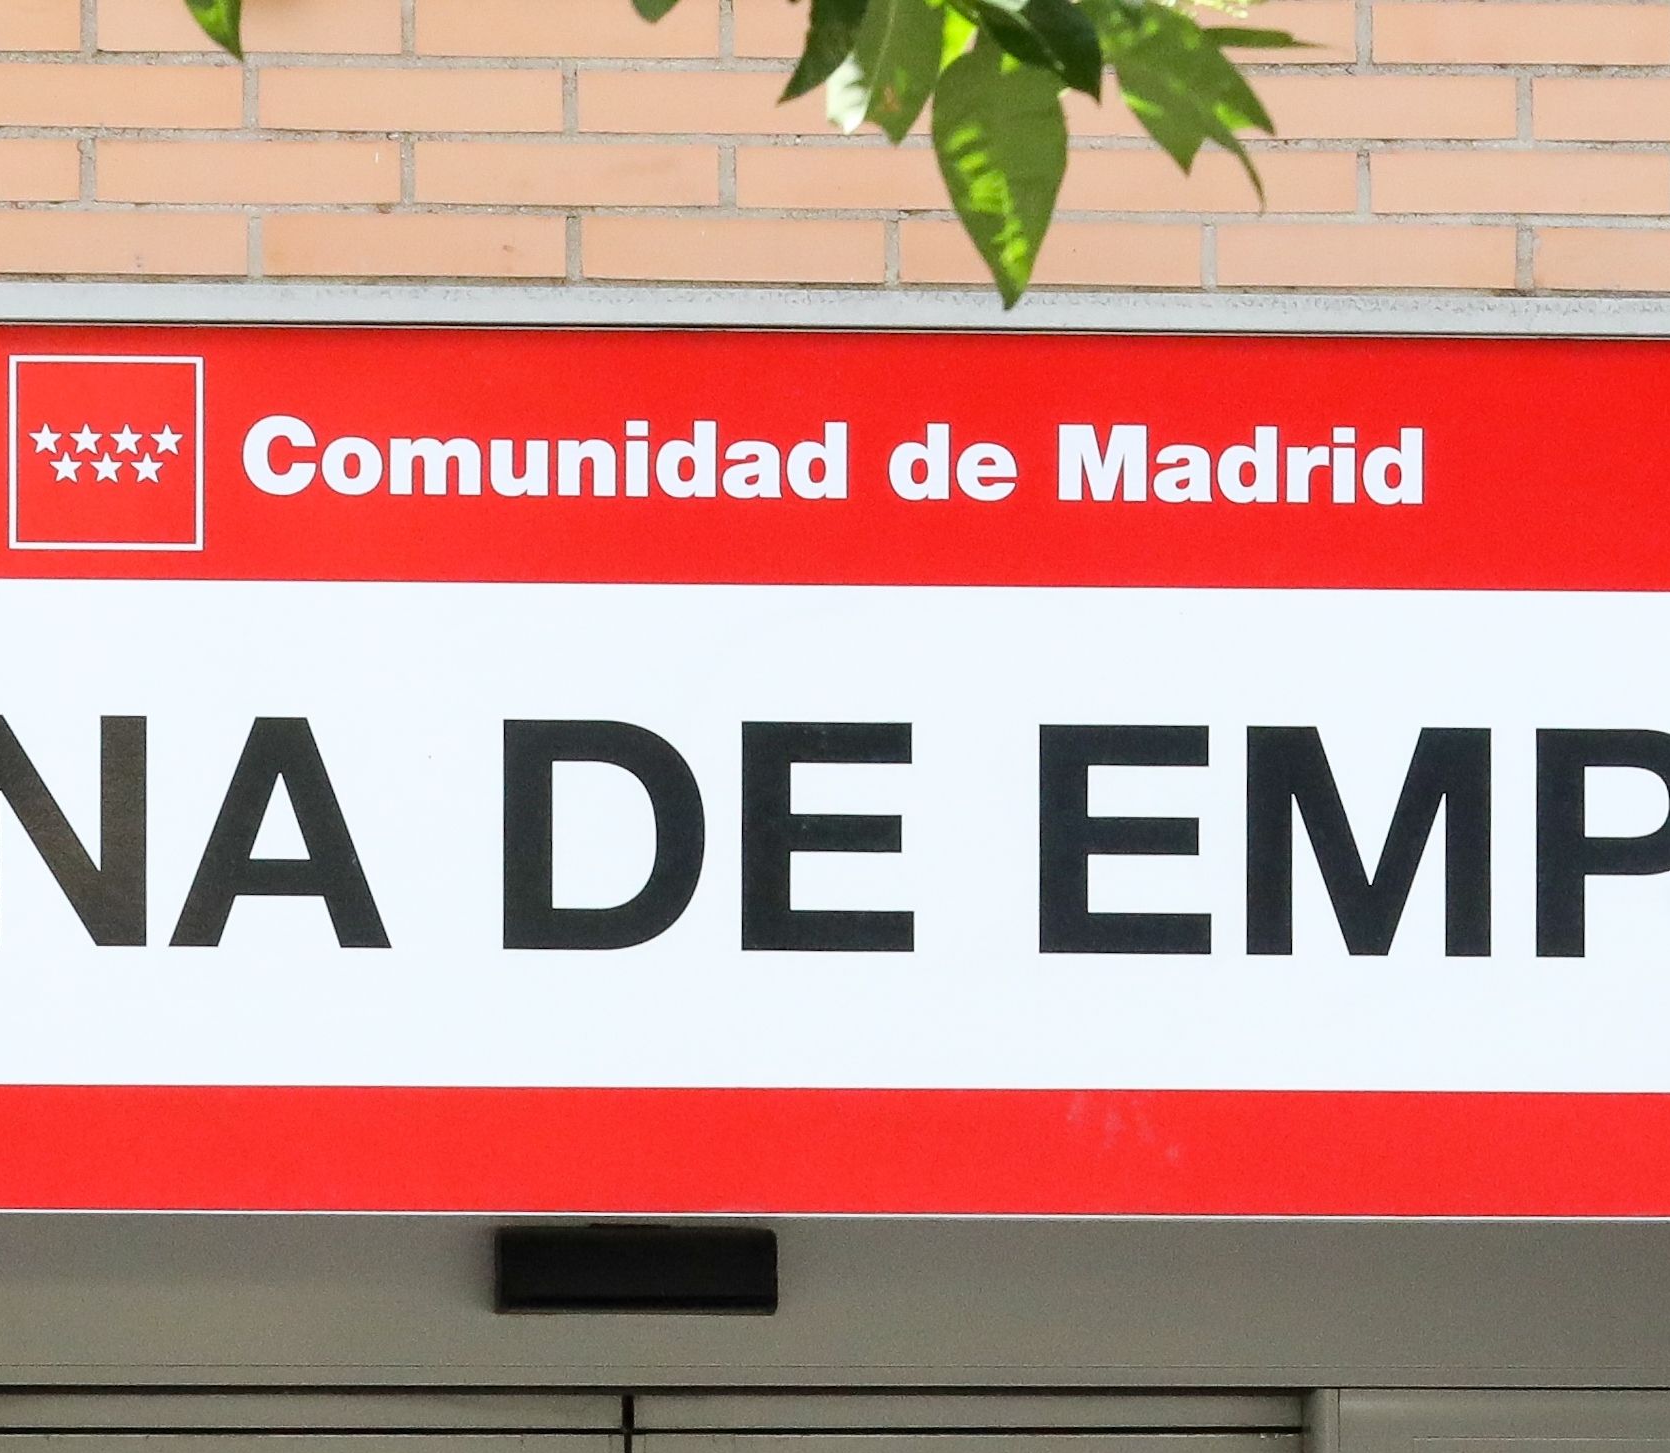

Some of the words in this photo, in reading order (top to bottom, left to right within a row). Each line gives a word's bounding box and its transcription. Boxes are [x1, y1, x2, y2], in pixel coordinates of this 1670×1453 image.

[241, 414, 850, 501] Comunidad
[888, 421, 1018, 503] de
[1056, 423, 1425, 507] Madrid
[502, 718, 915, 952] DE
